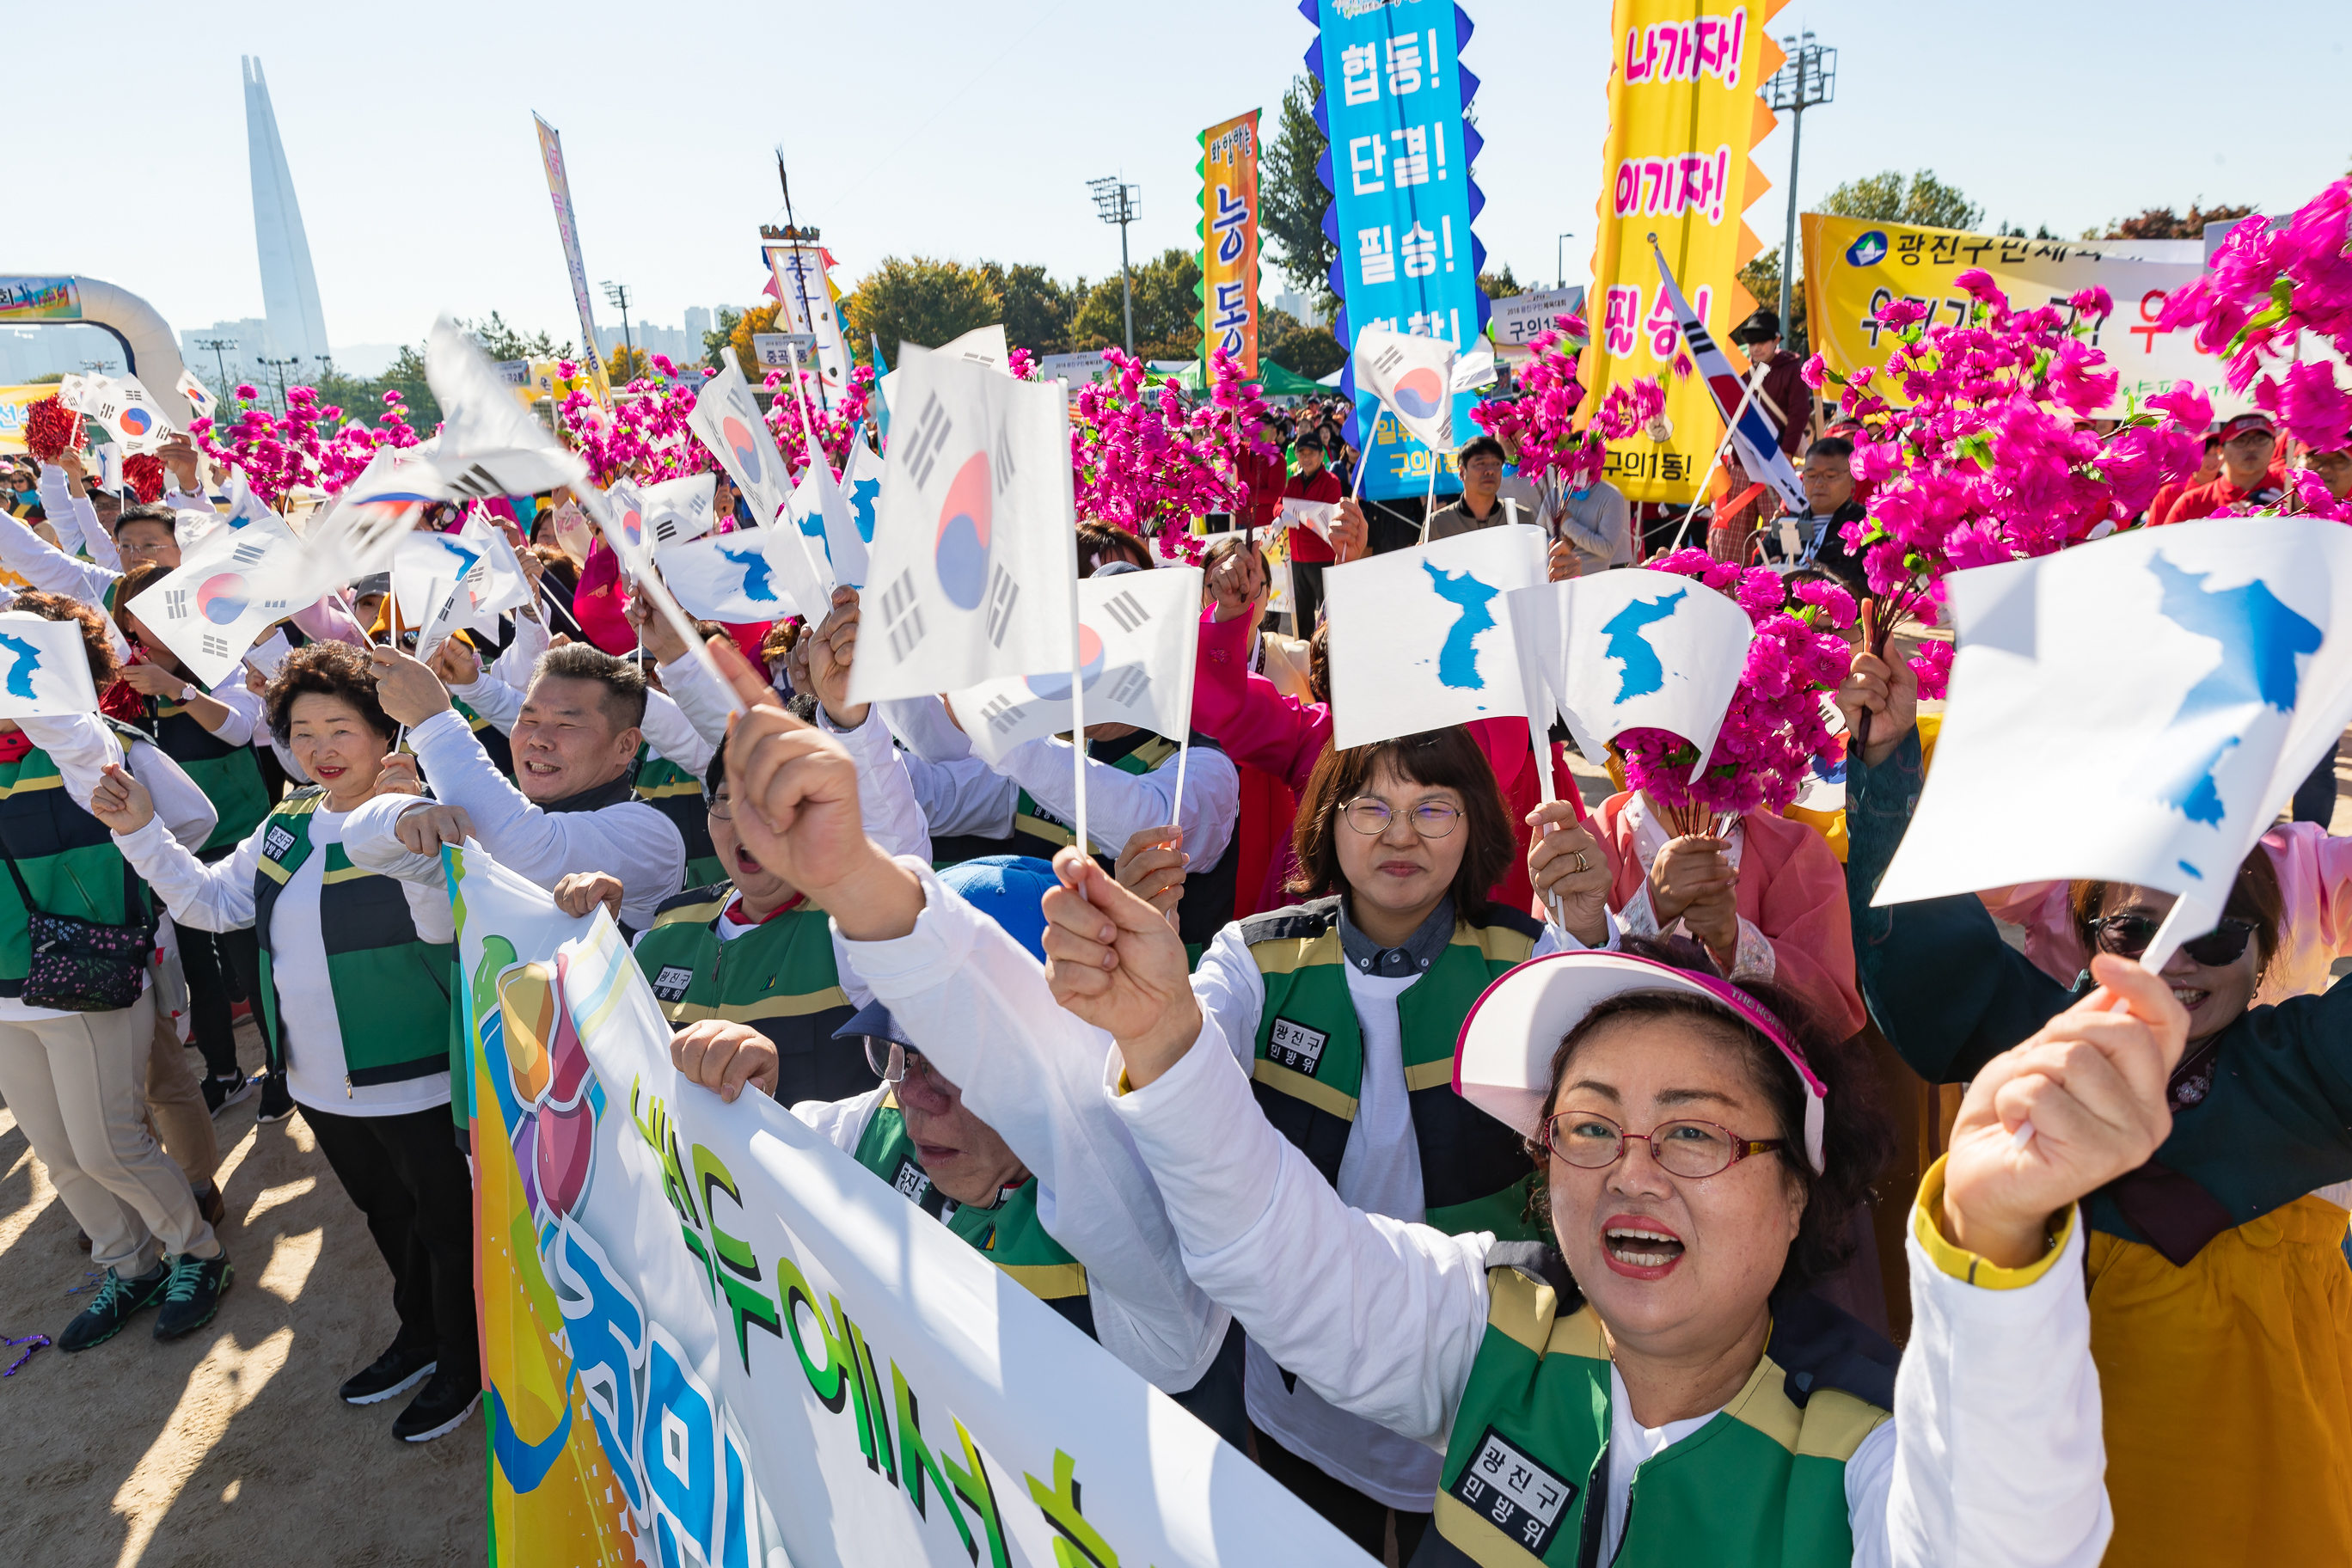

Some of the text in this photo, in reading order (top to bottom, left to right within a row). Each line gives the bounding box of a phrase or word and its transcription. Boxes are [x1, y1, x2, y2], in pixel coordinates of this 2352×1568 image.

[1341, 28, 1440, 104] 협동!
[1627, 12, 1743, 84] 나가자!
[1210, 124, 1252, 164] 화합하는
[1350, 121, 1447, 196] 단결!
[1616, 150, 1726, 220] 이기자!
[1213, 187, 1248, 357] 능동
[1358, 215, 1454, 285] 필승!
[767, 349, 807, 364] 중곡동
[1602, 451, 1692, 481] 구의1동!
[269, 828, 293, 848] 광진구
[659, 971, 691, 986] 광진구
[1730, 987, 1755, 1010] THE
[1270, 1044, 1315, 1074] 민방위
[1276, 1025, 1320, 1052] 광진구
[1483, 1445, 1560, 1510] 광진구
[1461, 1474, 1547, 1548] 민방위
